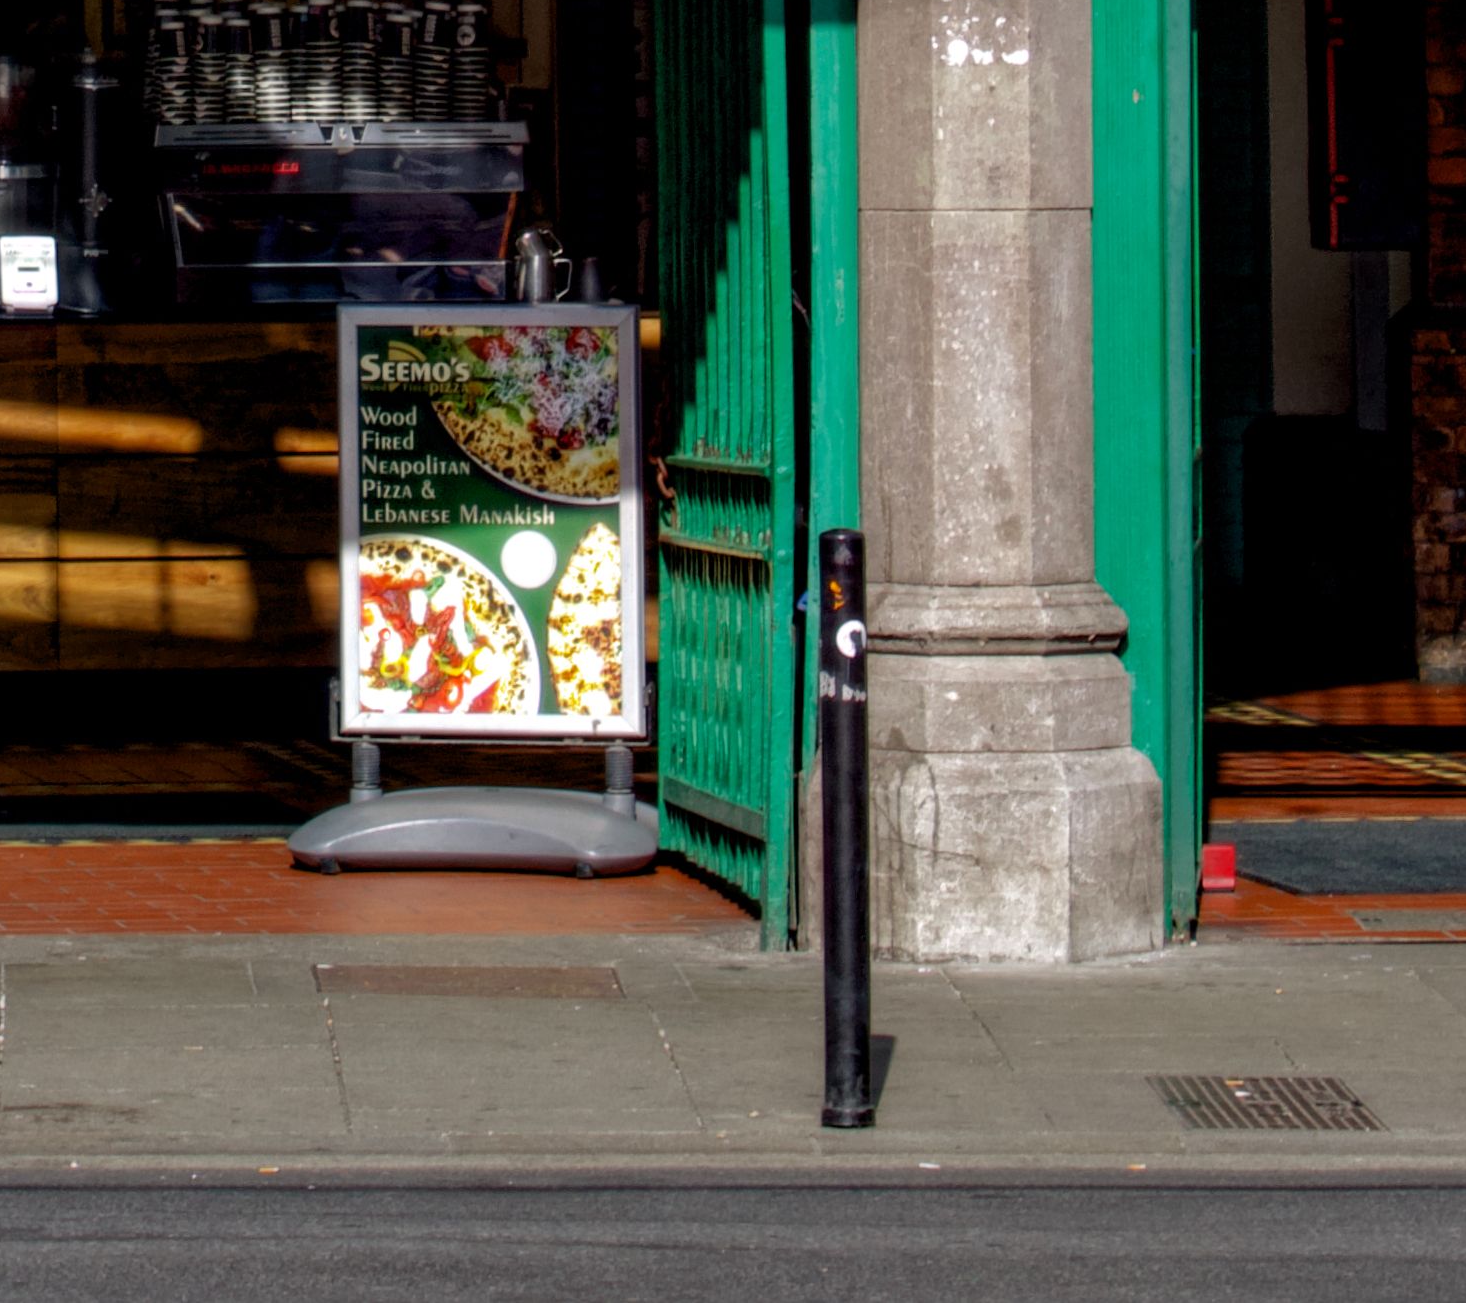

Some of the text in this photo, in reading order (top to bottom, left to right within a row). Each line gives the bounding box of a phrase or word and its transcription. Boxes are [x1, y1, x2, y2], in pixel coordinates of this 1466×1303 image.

[360, 354, 470, 382] SEEMO'S
[361, 406, 417, 426] Wood
[421, 481, 435, 499] &
